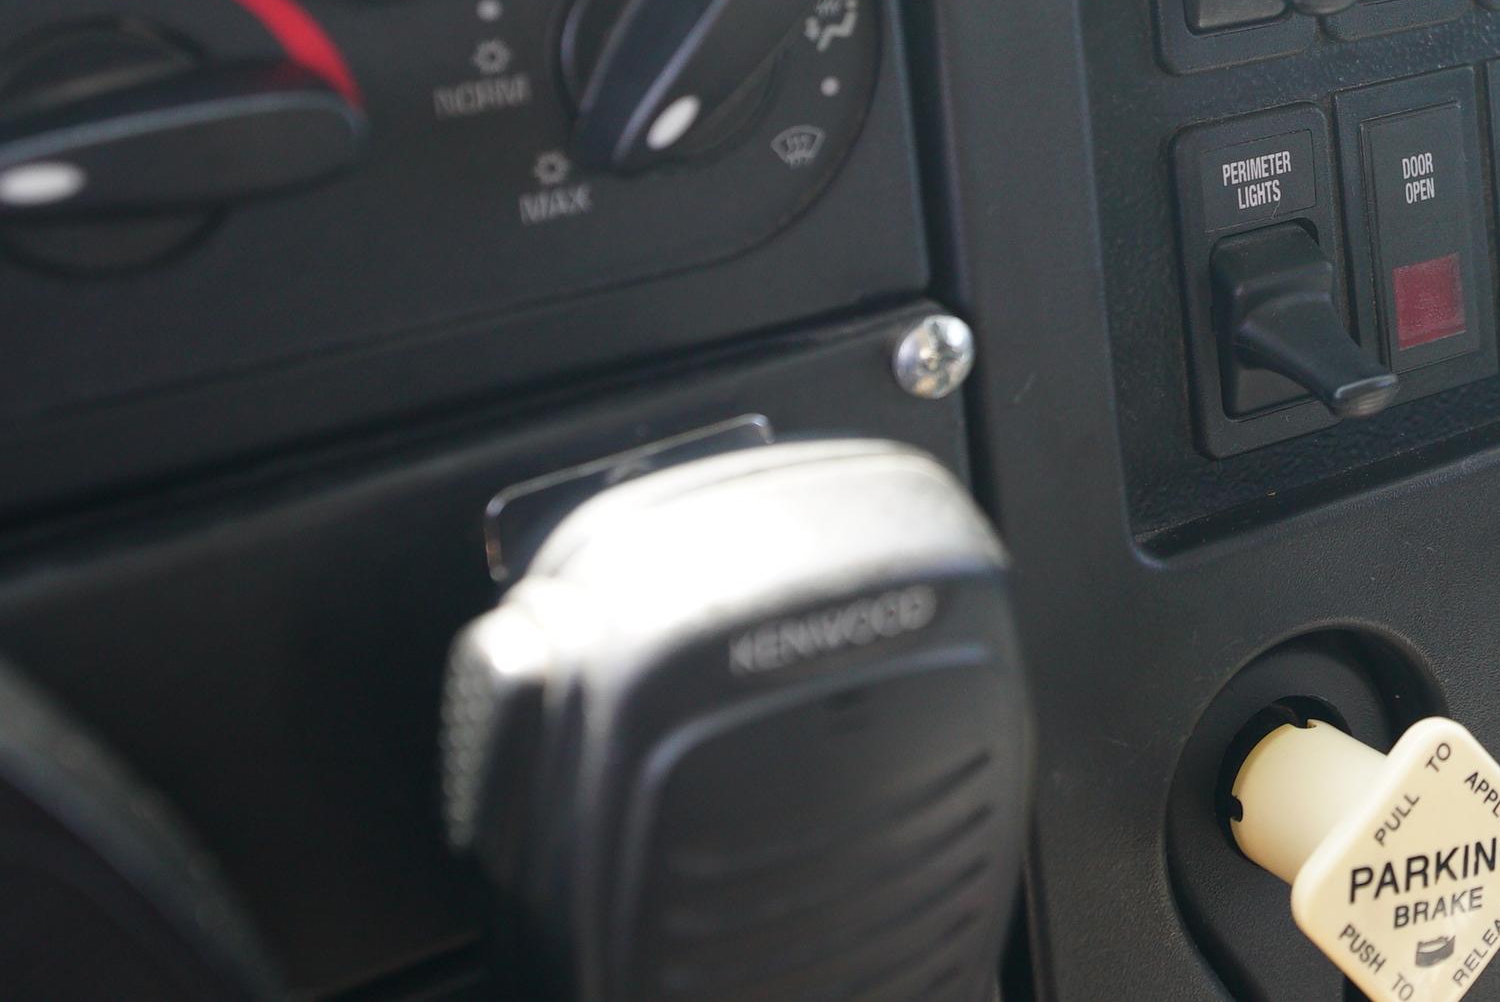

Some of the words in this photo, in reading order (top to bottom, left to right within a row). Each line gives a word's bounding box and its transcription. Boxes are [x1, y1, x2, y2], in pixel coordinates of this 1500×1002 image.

[434, 73, 530, 117] NORM
[1222, 150, 1292, 187] PERIMETER
[1402, 152, 1434, 180] DOOR
[518, 185, 591, 225] MAX
[1237, 179, 1281, 210] LIGHTS
[1405, 177, 1435, 204] OPEN
[728, 585, 936, 678] KENWOOD
[1374, 793, 1420, 847] PULL
[1425, 742, 1451, 773] TO
[1393, 886, 1484, 930] BRAKE
[1338, 924, 1386, 973] PUSH
[1391, 973, 1415, 1002] TO
